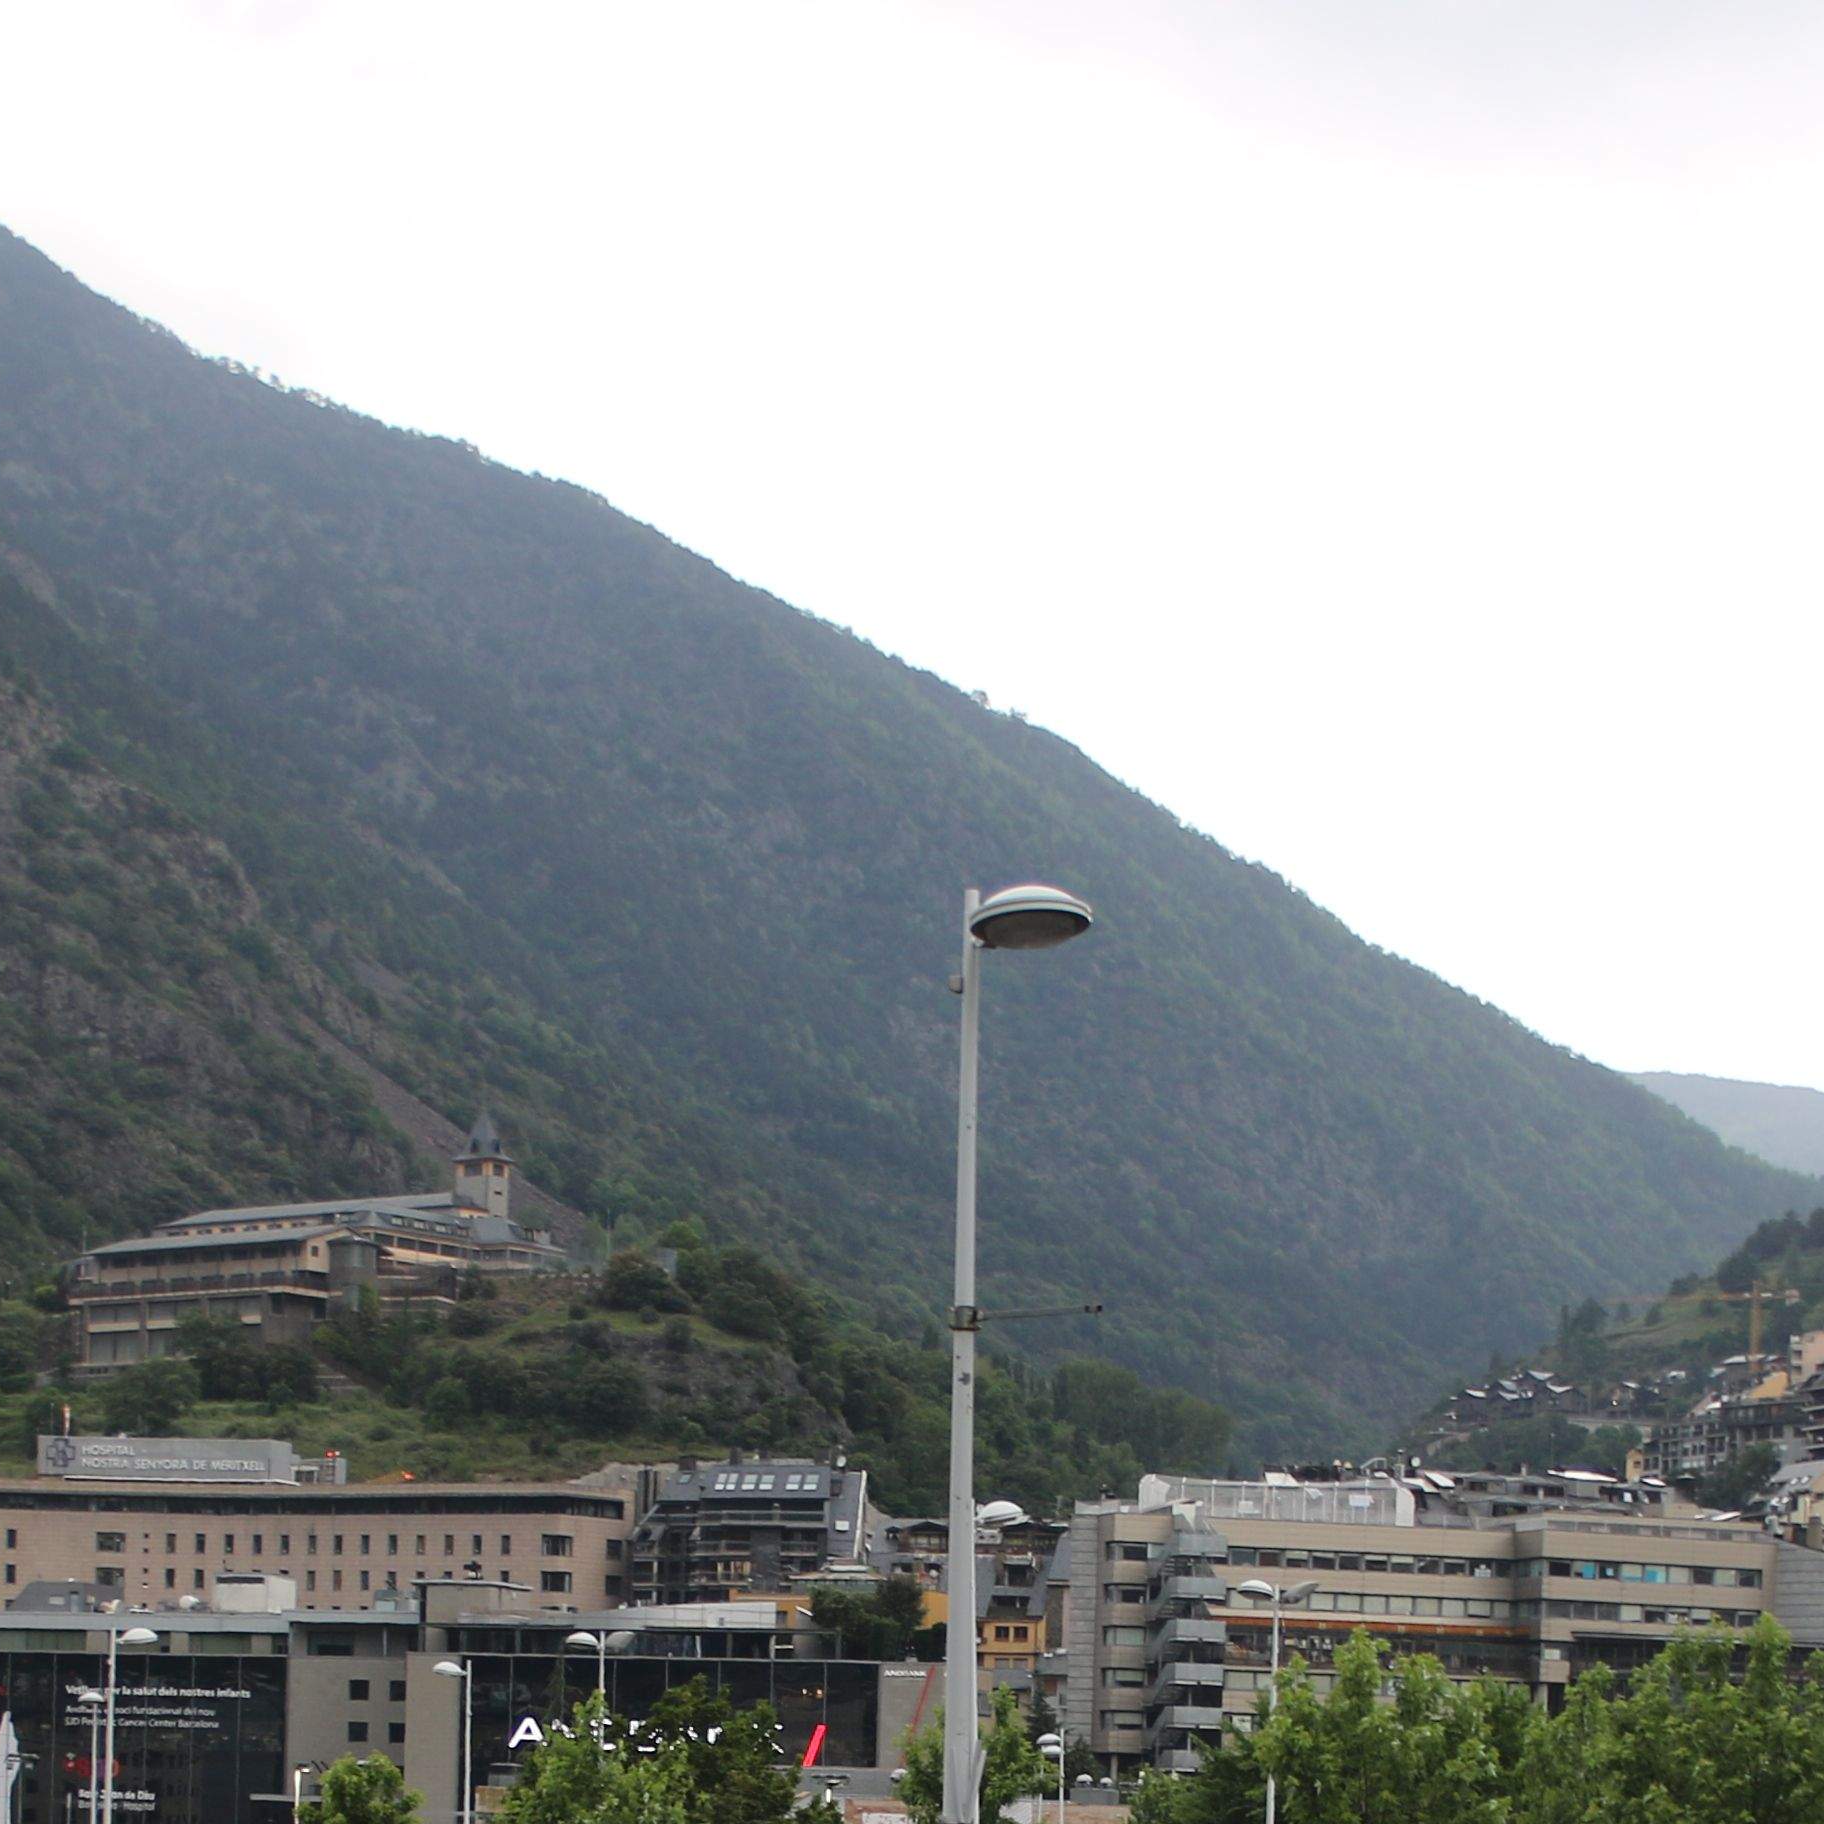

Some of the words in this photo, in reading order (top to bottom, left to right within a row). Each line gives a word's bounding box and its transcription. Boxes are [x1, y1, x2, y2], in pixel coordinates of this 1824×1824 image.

[82, 1445, 136, 1456] HOSPITAL
[82, 1458, 128, 1469] NOSTRA
[134, 1459, 188, 1470] SENYORA
[193, 1460, 206, 1470] DE
[211, 1460, 266, 1471] MERITXELL
[132, 1685, 157, 1697] salut
[158, 1686, 179, 1697] dels
[179, 1687, 215, 1698] nostres
[217, 1687, 251, 1699] infants
